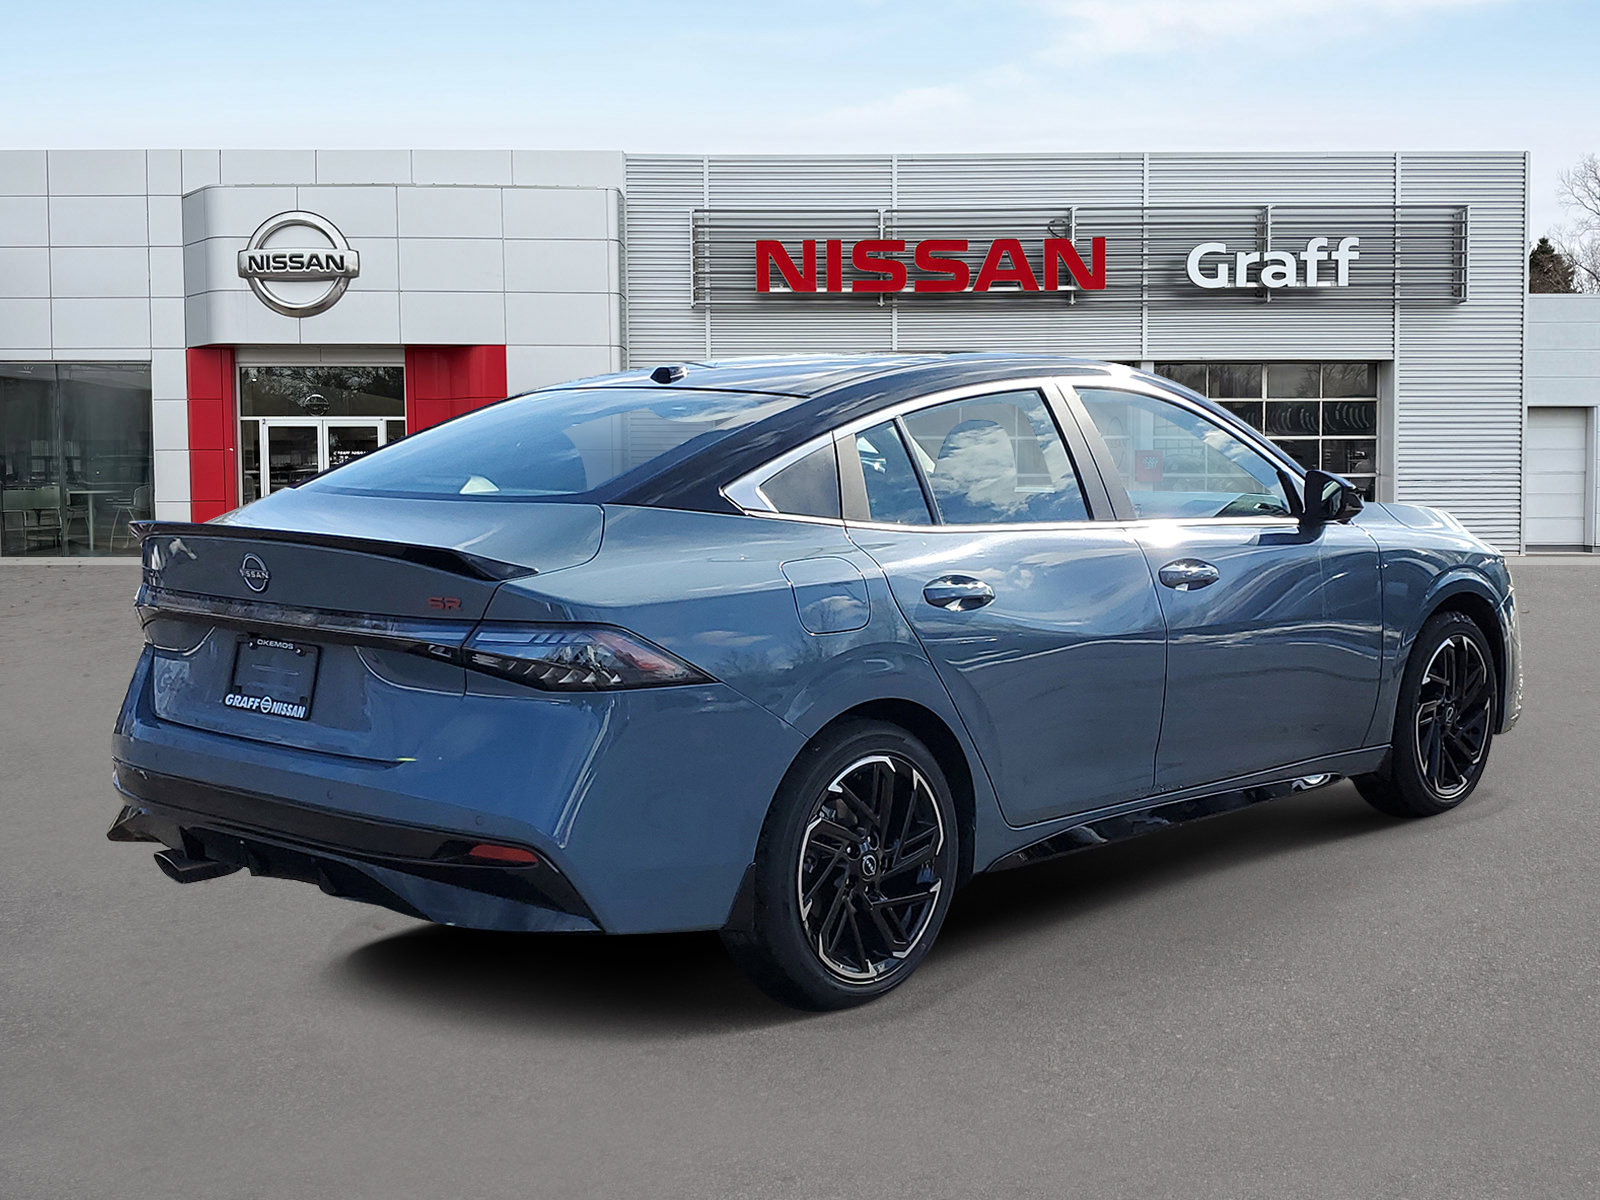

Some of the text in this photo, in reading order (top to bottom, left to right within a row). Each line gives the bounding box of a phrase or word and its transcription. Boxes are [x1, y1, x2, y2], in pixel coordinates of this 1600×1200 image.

[248, 253, 344, 271] NISSAN
[756, 237, 1106, 292] NISSAN
[1187, 237, 1360, 288] Graff
[428, 597, 461, 610] SR
[257, 639, 294, 650] OKEMOS
[225, 693, 306, 718] GRAFF NISSAN
